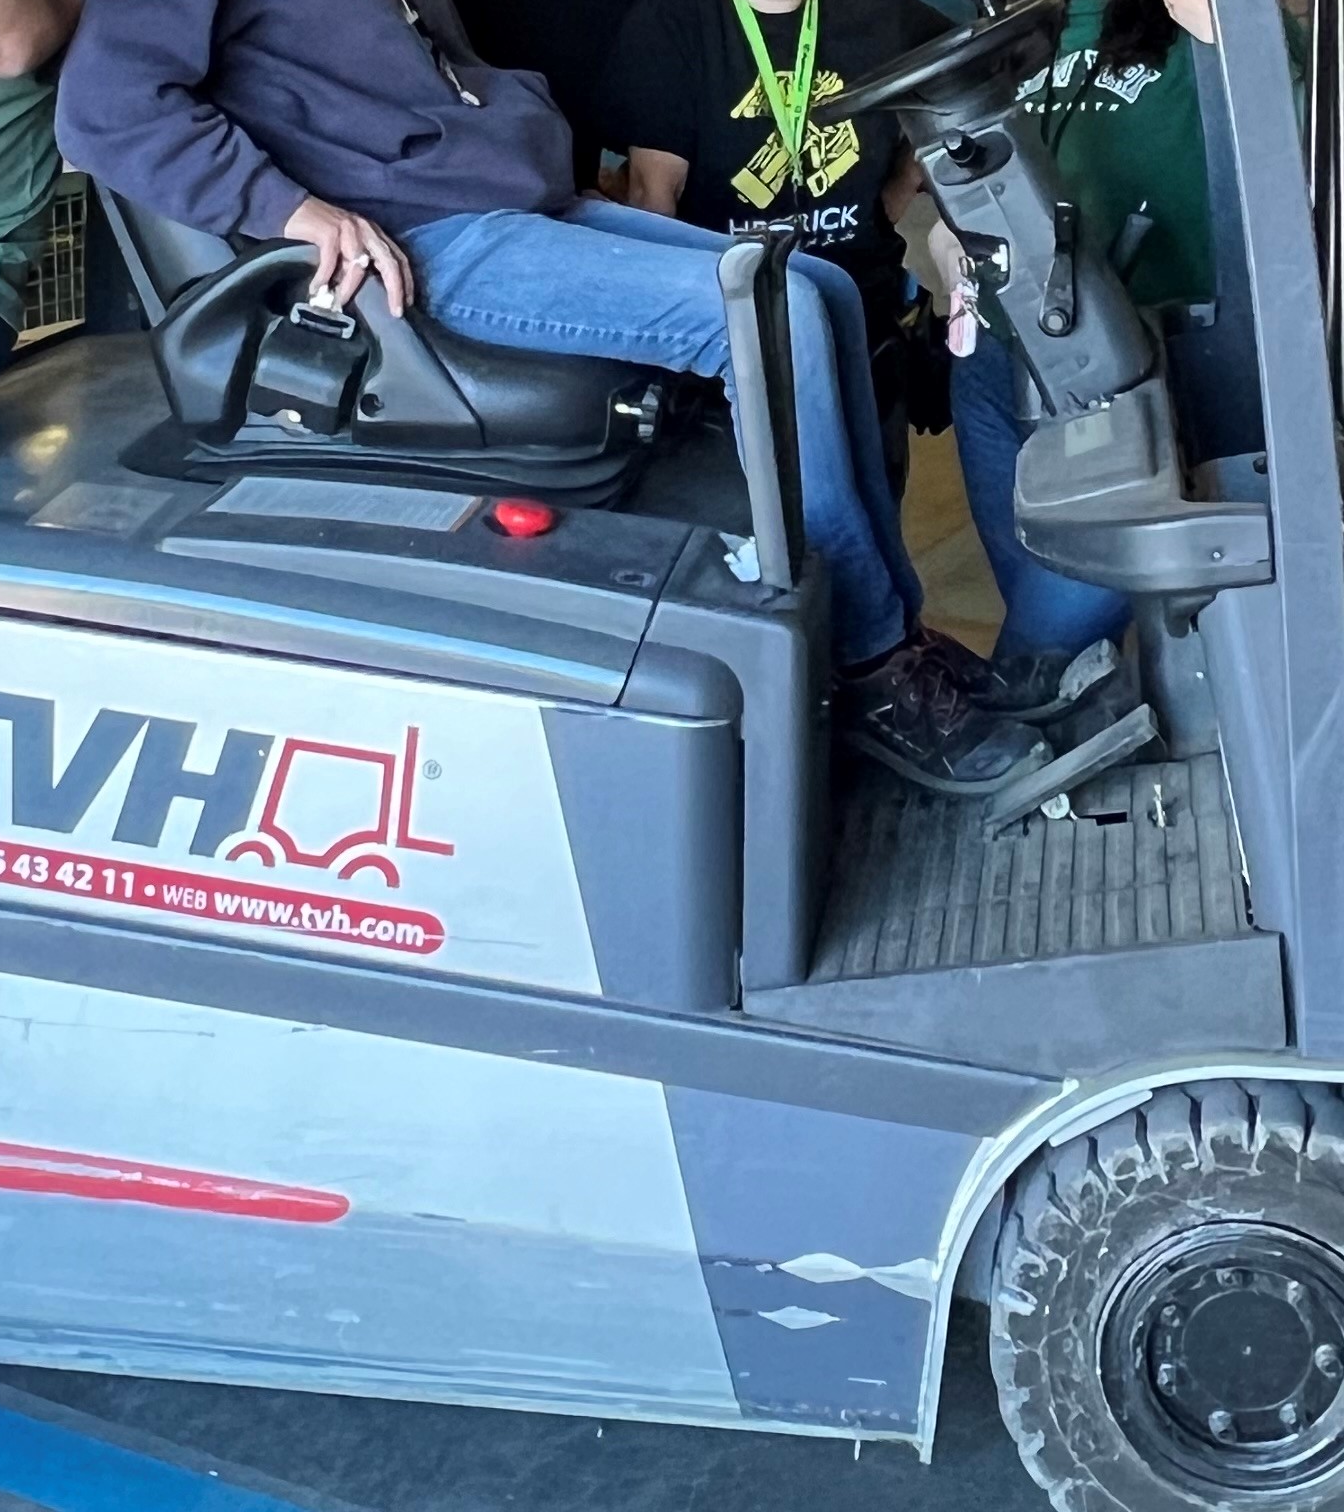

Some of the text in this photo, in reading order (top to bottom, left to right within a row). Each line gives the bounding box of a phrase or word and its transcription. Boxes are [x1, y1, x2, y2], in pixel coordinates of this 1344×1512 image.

[12, 853, 50, 883] 43
[55, 862, 94, 891] 42
[102, 868, 135, 898] 11
[162, 884, 207, 910] WEB
[213, 891, 425, 947] www.tvh.com
